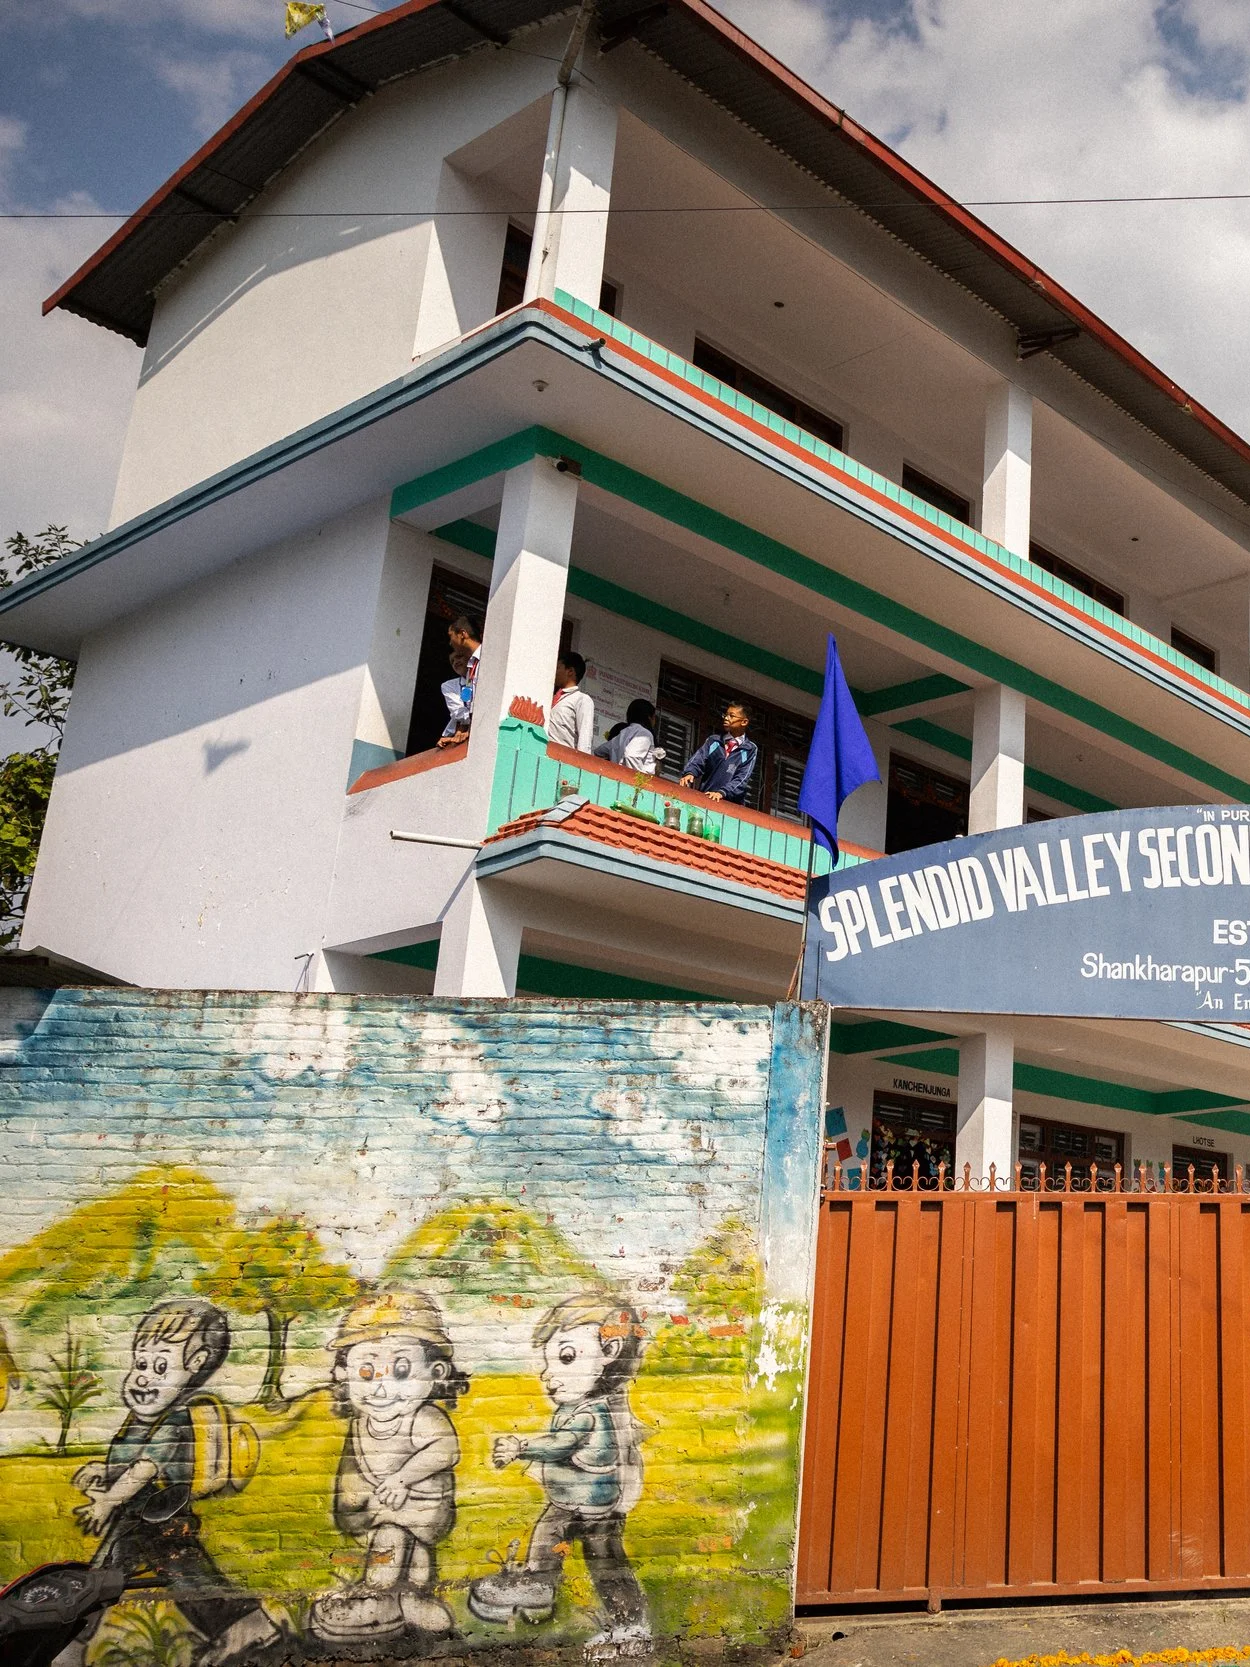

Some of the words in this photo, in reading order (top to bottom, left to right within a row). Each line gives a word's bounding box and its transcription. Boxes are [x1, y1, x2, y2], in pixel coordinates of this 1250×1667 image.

[819, 856, 995, 962] SPLENDID
[989, 831, 1132, 912] VALLEY
[893, 1078, 951, 1098] KANCHENJUNGA
[1192, 1136, 1215, 1148] LHOTSE
